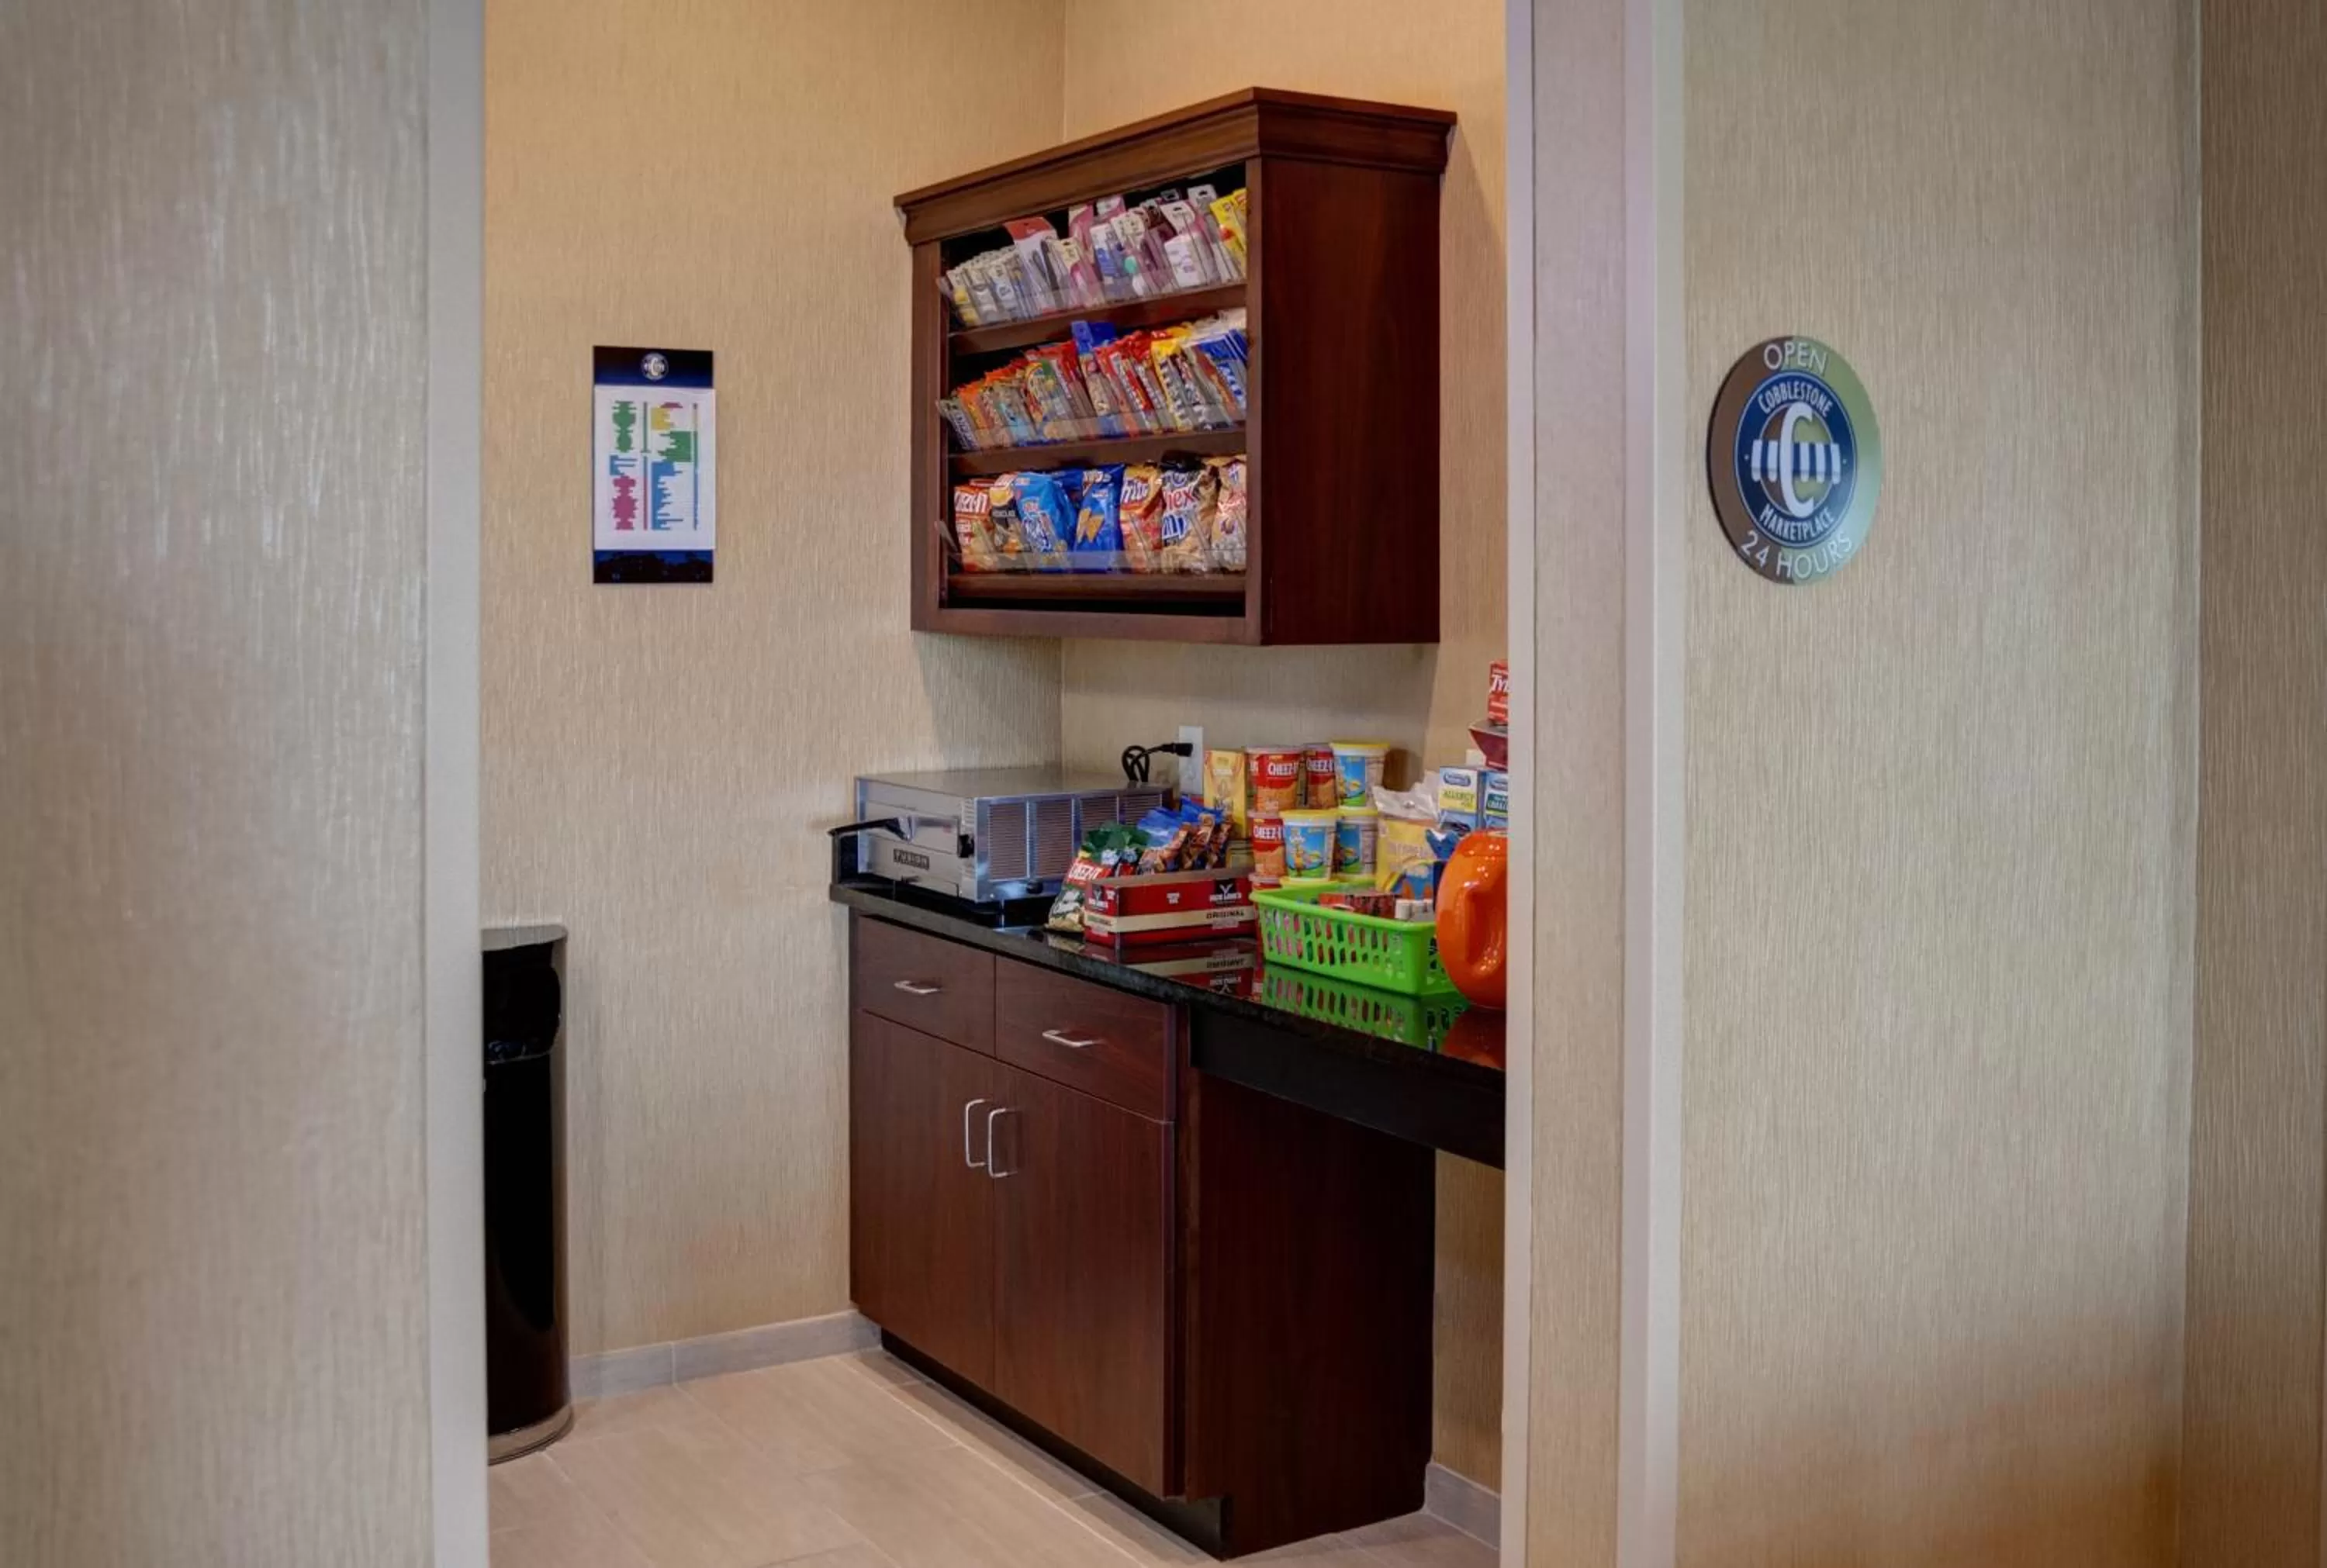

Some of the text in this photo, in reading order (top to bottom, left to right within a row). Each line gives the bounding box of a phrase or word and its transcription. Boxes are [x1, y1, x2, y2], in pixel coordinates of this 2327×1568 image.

[1763, 340, 1828, 375] OPEN
[1757, 380, 1834, 418] COBBLESTONE
[1759, 503, 1834, 541] MARKETPLACE
[1741, 530, 1853, 579] 24 HOURS
